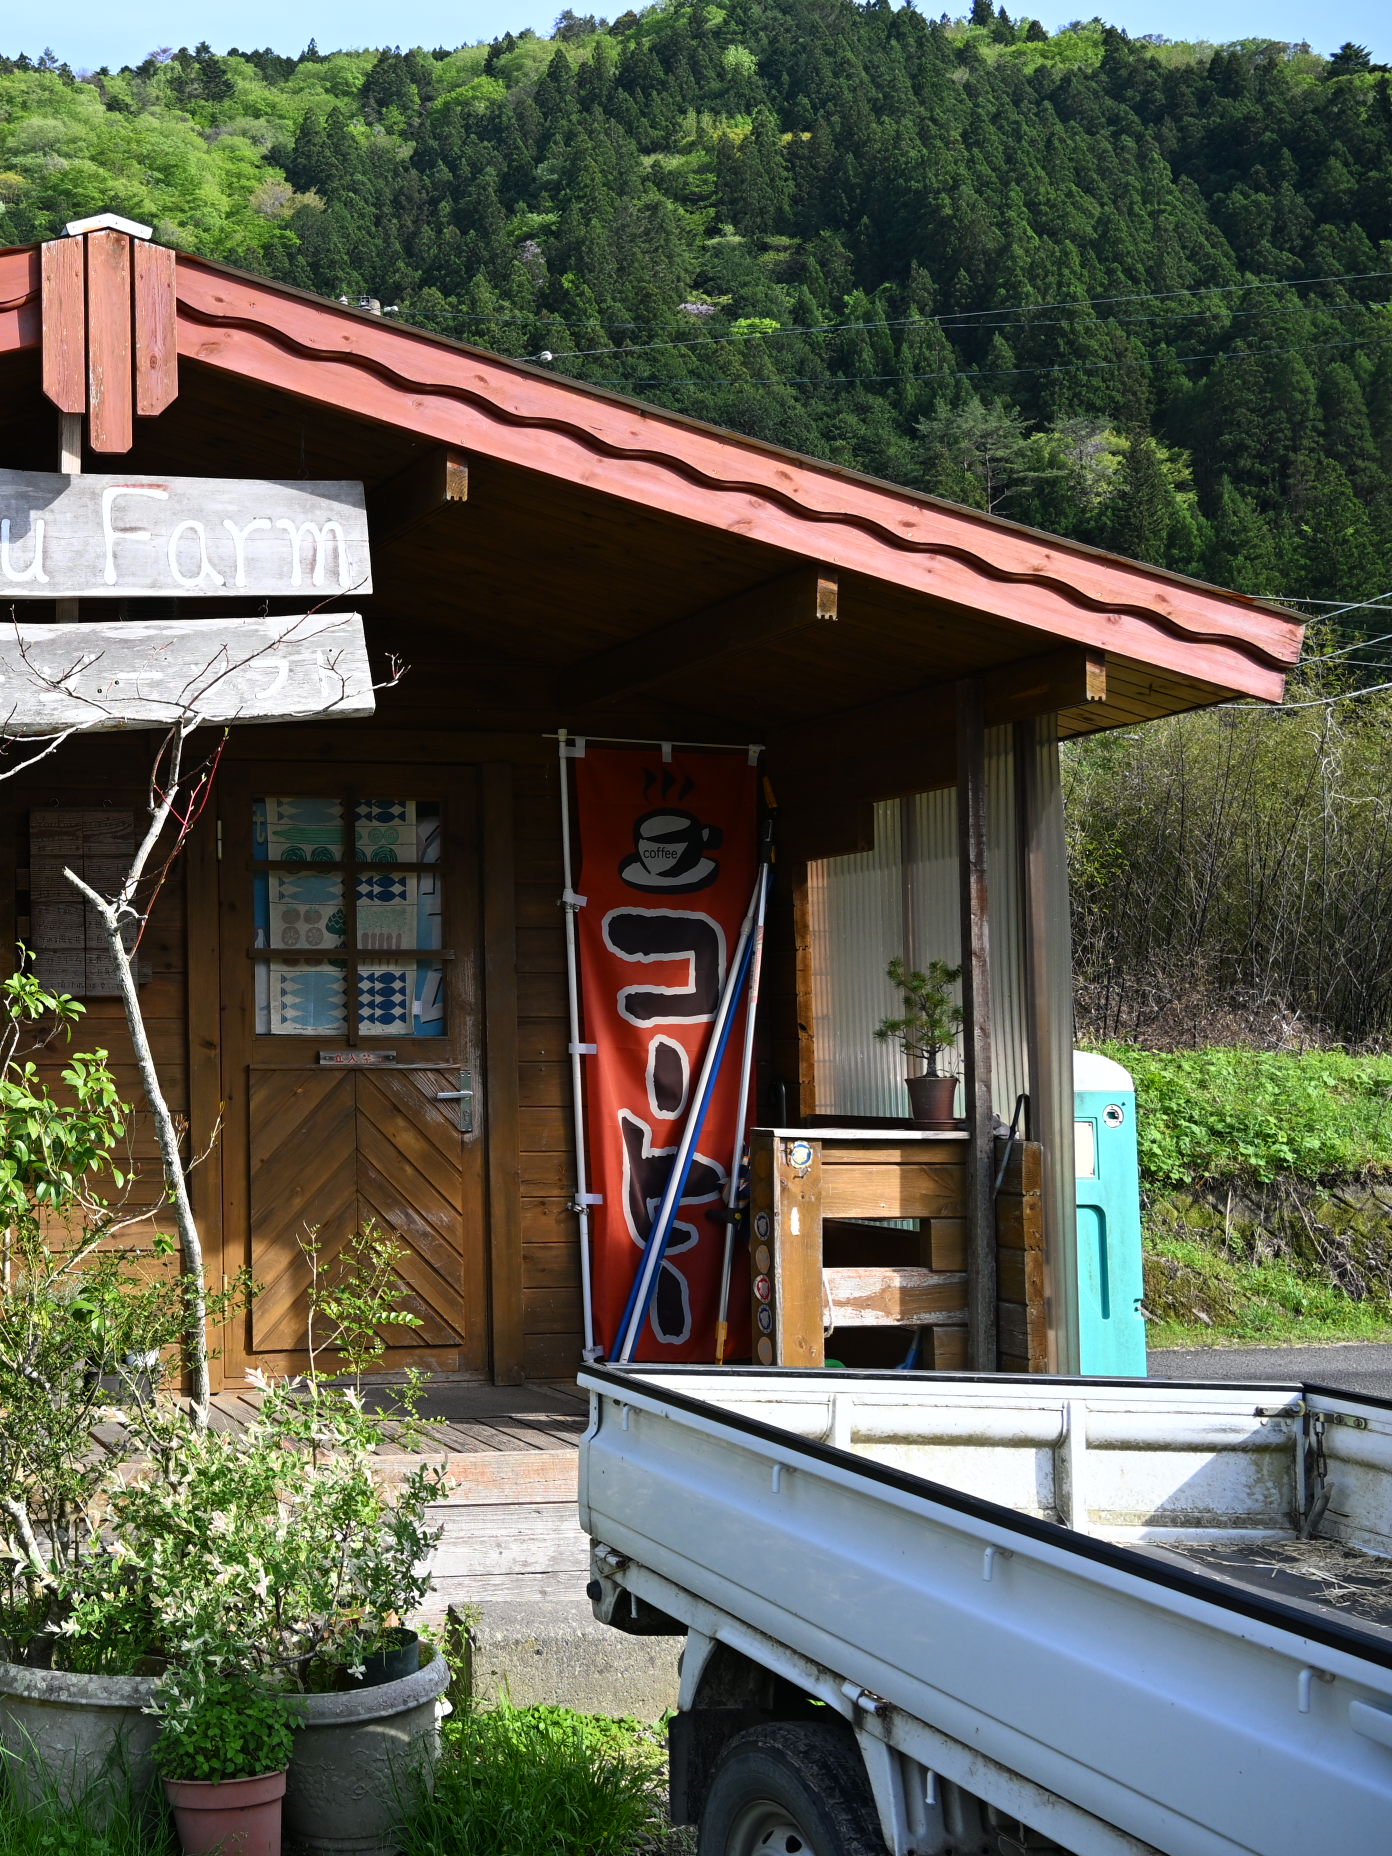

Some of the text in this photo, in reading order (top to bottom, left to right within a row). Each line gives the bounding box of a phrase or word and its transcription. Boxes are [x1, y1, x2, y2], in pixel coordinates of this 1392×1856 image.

[102, 484, 352, 588] Farm
[643, 847, 678, 859] coffee
[602, 907, 728, 1345] コーヒー
